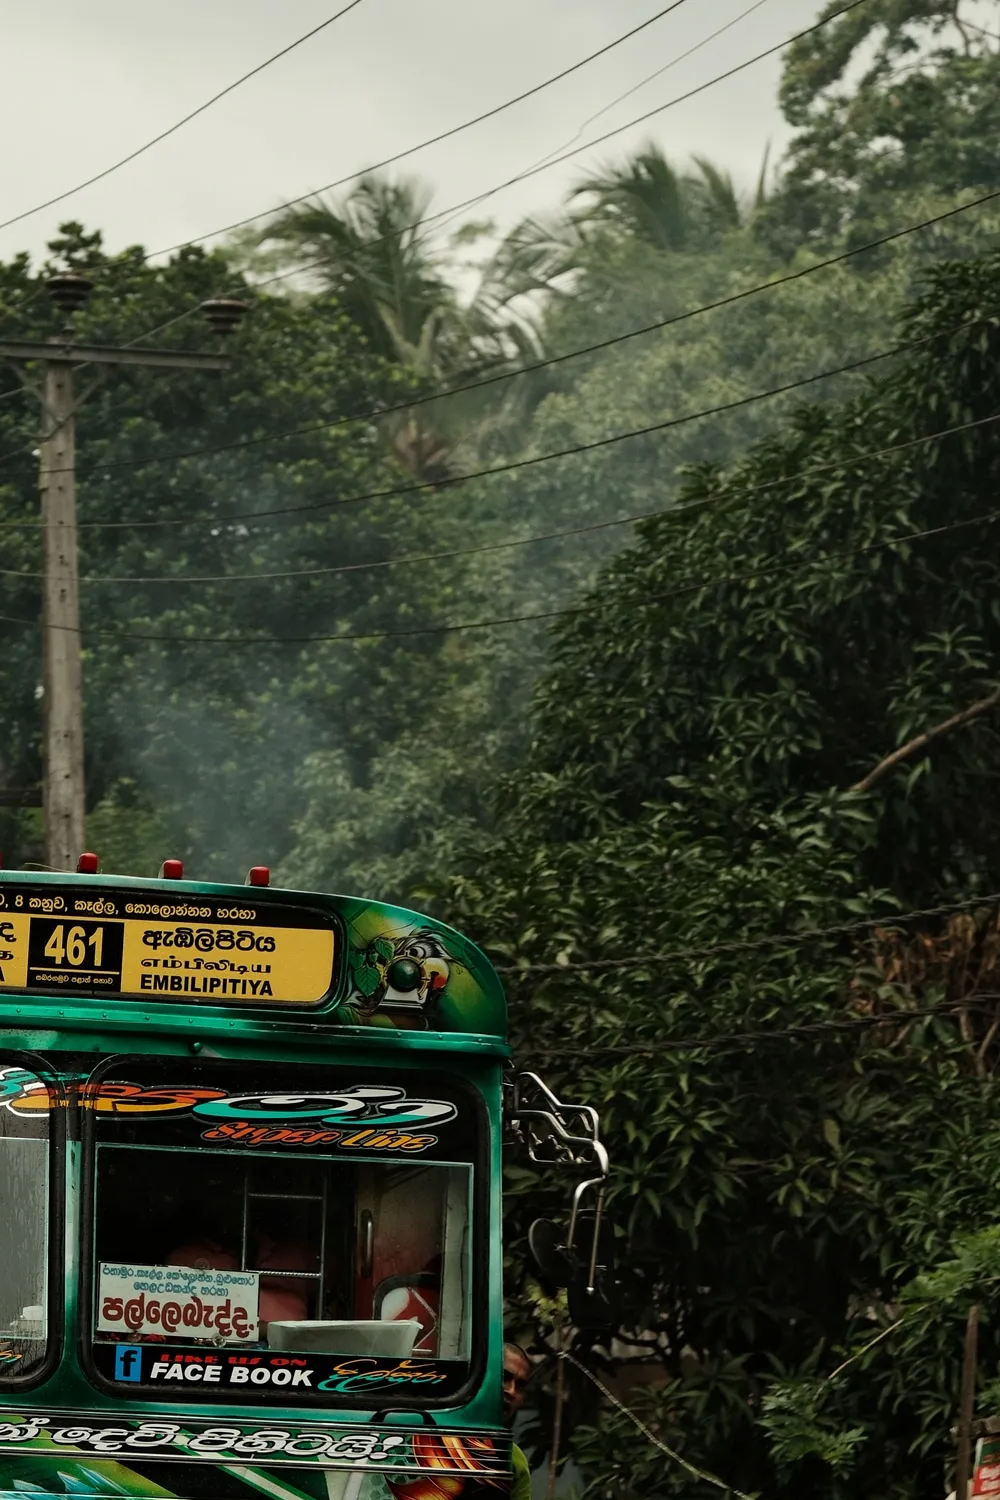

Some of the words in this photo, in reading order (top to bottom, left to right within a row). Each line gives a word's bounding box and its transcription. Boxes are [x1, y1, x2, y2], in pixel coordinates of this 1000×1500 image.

[14, 895, 24, 907] 8
[216, 907, 256, 920] හරහා
[44, 925, 103, 967] 461
[142, 927, 276, 952] ඇඹිලිපිටිය
[140, 974, 273, 996] EMBILIPITIYA
[203, 1122, 341, 1146] Super
[339, 1130, 438, 1153] Line
[160, 1354, 218, 1364] LIKE
[270, 1358, 308, 1366] ON
[150, 1362, 223, 1382] FACE
[229, 1366, 314, 1387] BOOK
